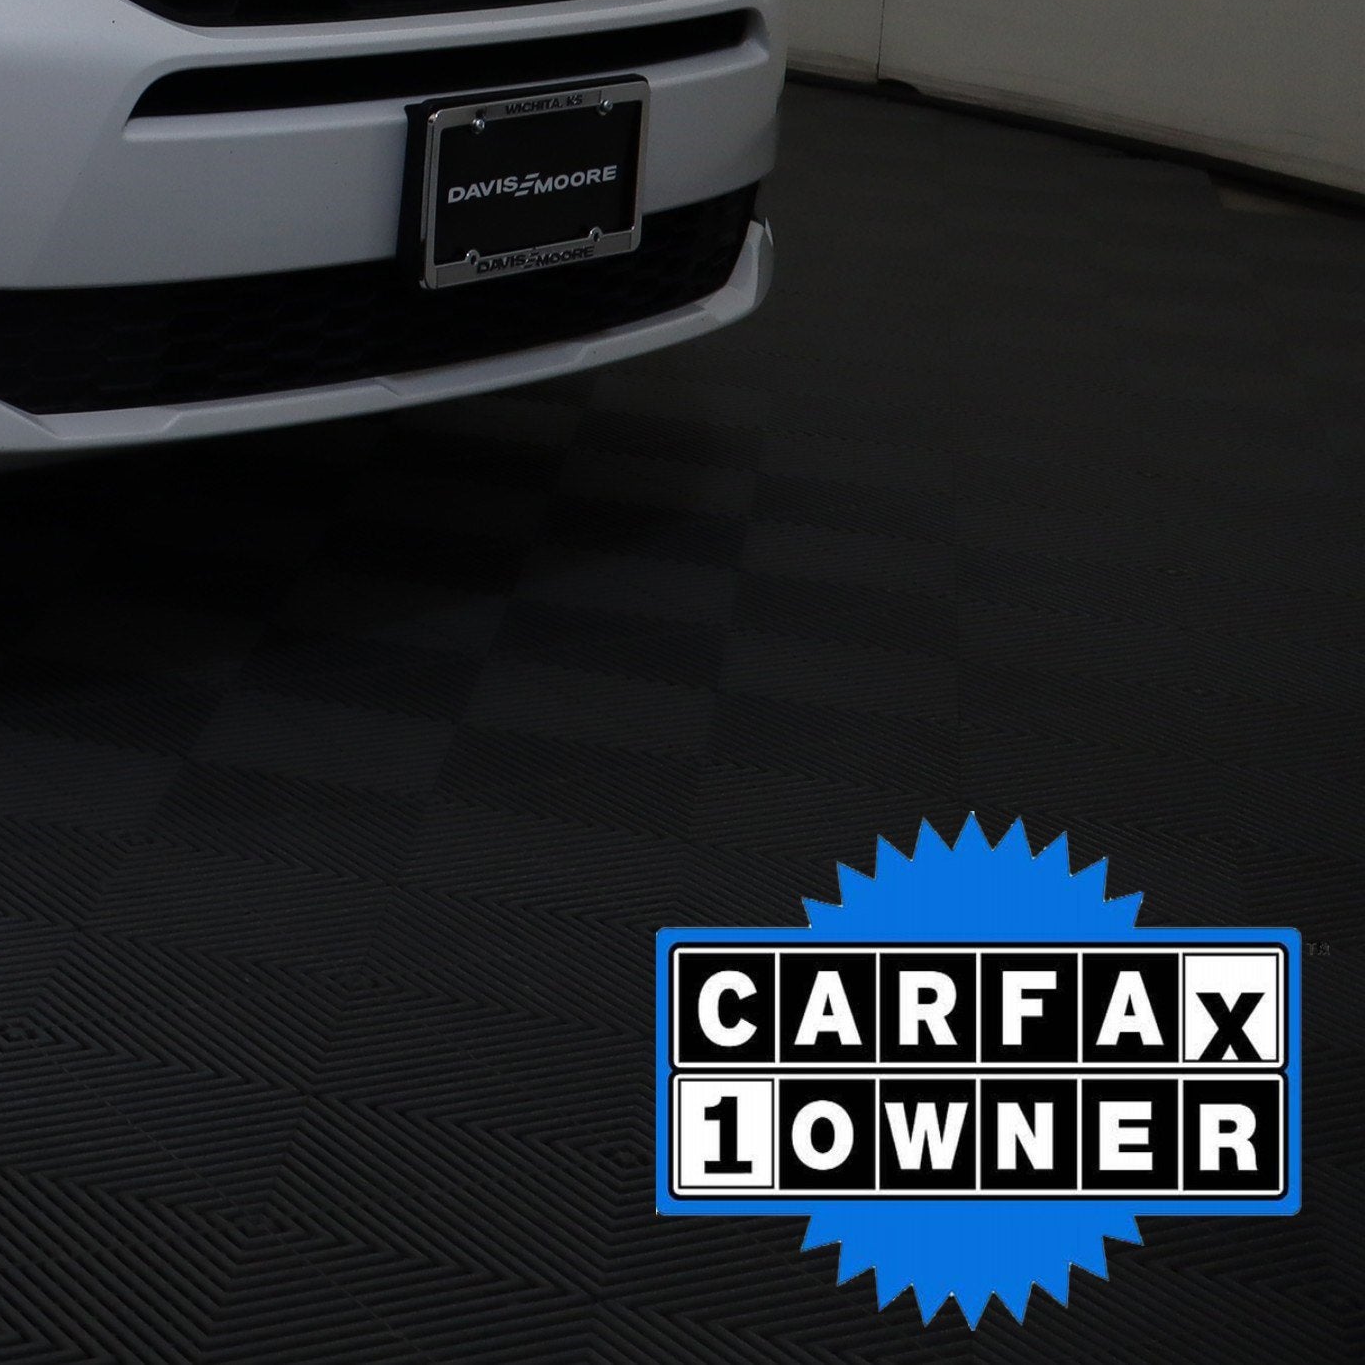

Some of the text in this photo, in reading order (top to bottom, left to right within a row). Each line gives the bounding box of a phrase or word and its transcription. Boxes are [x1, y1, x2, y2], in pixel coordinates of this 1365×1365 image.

[447, 165, 617, 204] DAVIS MOORE
[477, 245, 595, 274] DAVIS MOORE
